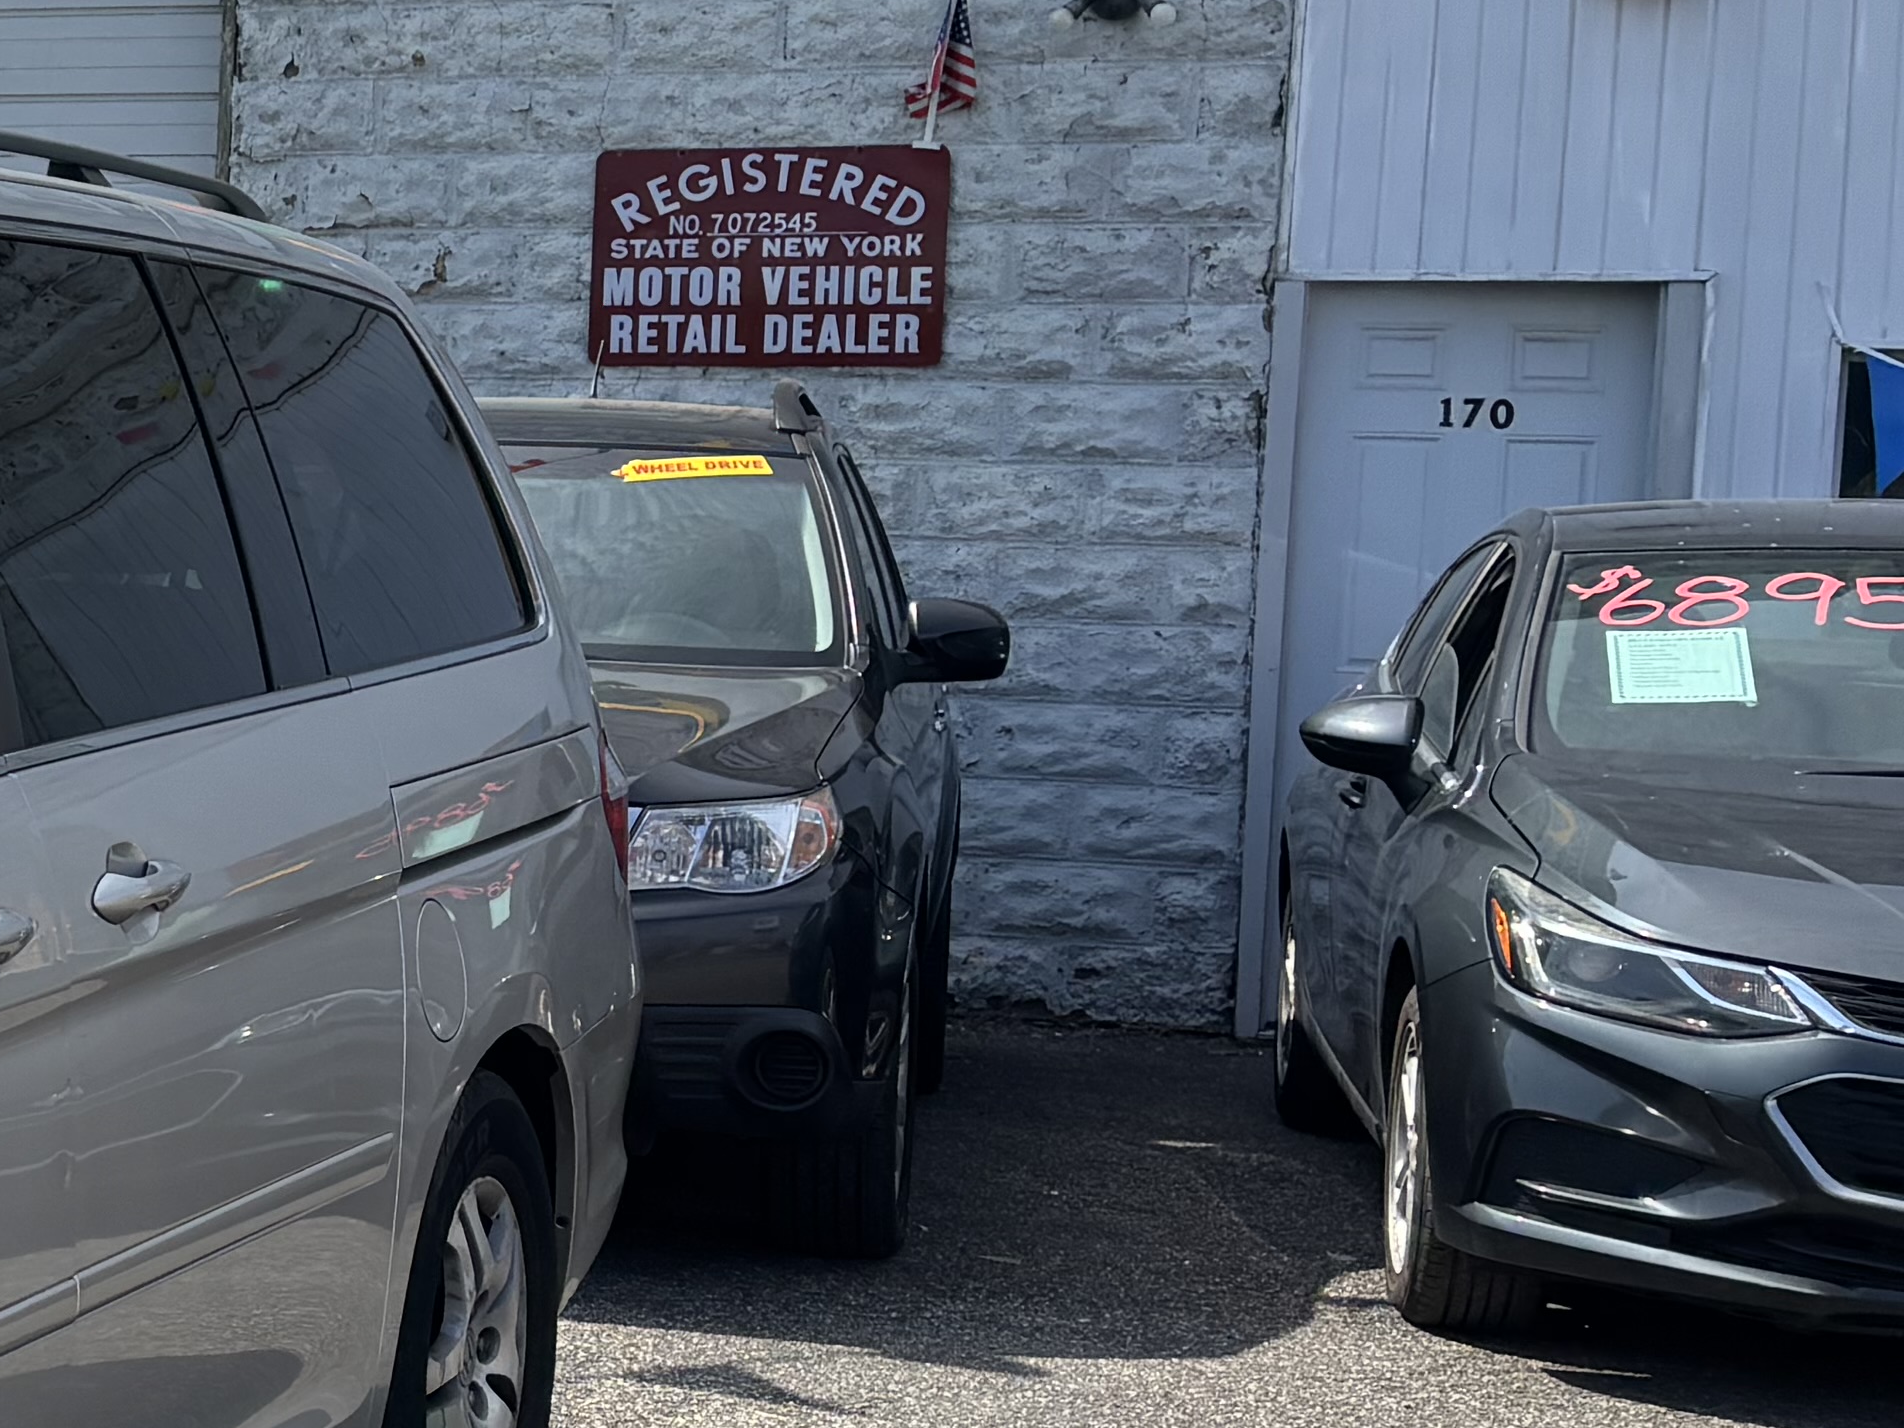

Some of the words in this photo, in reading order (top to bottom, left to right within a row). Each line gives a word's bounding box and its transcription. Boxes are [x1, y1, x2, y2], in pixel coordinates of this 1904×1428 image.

[611, 153, 926, 232] REGISTERED
[669, 215, 703, 236] NO.
[711, 212, 817, 234] 7072545
[610, 238, 699, 259] STATE
[711, 237, 752, 259] OF
[761, 237, 829, 258] NEW
[840, 233, 924, 257] YORK
[602, 267, 742, 306] MOTOR
[761, 266, 933, 306] VEHICLE
[609, 313, 746, 354] RETAIL
[763, 313, 920, 354] DEALER
[1438, 397, 1515, 429] 170
[632, 462, 699, 475] WHEEL
[704, 460, 764, 470] DRIVE
